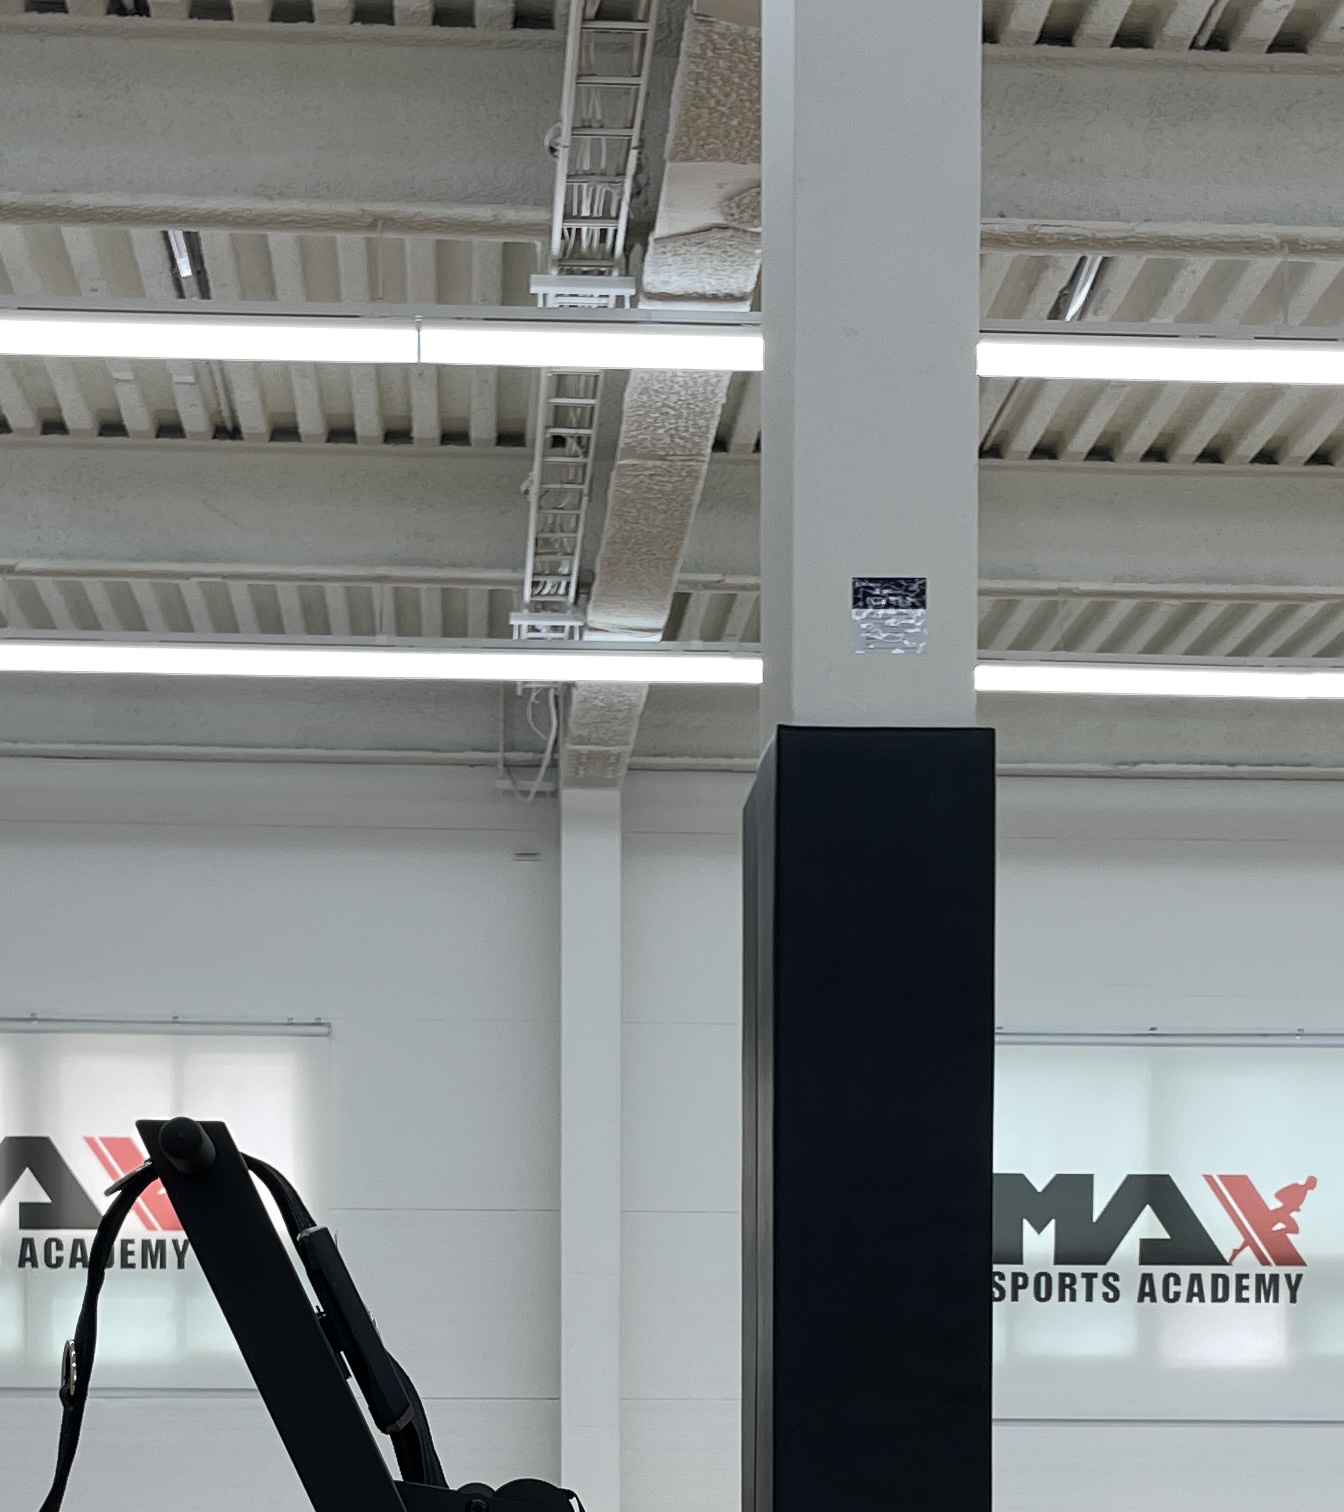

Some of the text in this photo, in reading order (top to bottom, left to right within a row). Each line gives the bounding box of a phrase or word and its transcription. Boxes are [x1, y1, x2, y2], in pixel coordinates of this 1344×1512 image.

[992, 1173, 1317, 1266] MAX
[992, 1271, 1304, 1304] SPORTS ACADEMY
